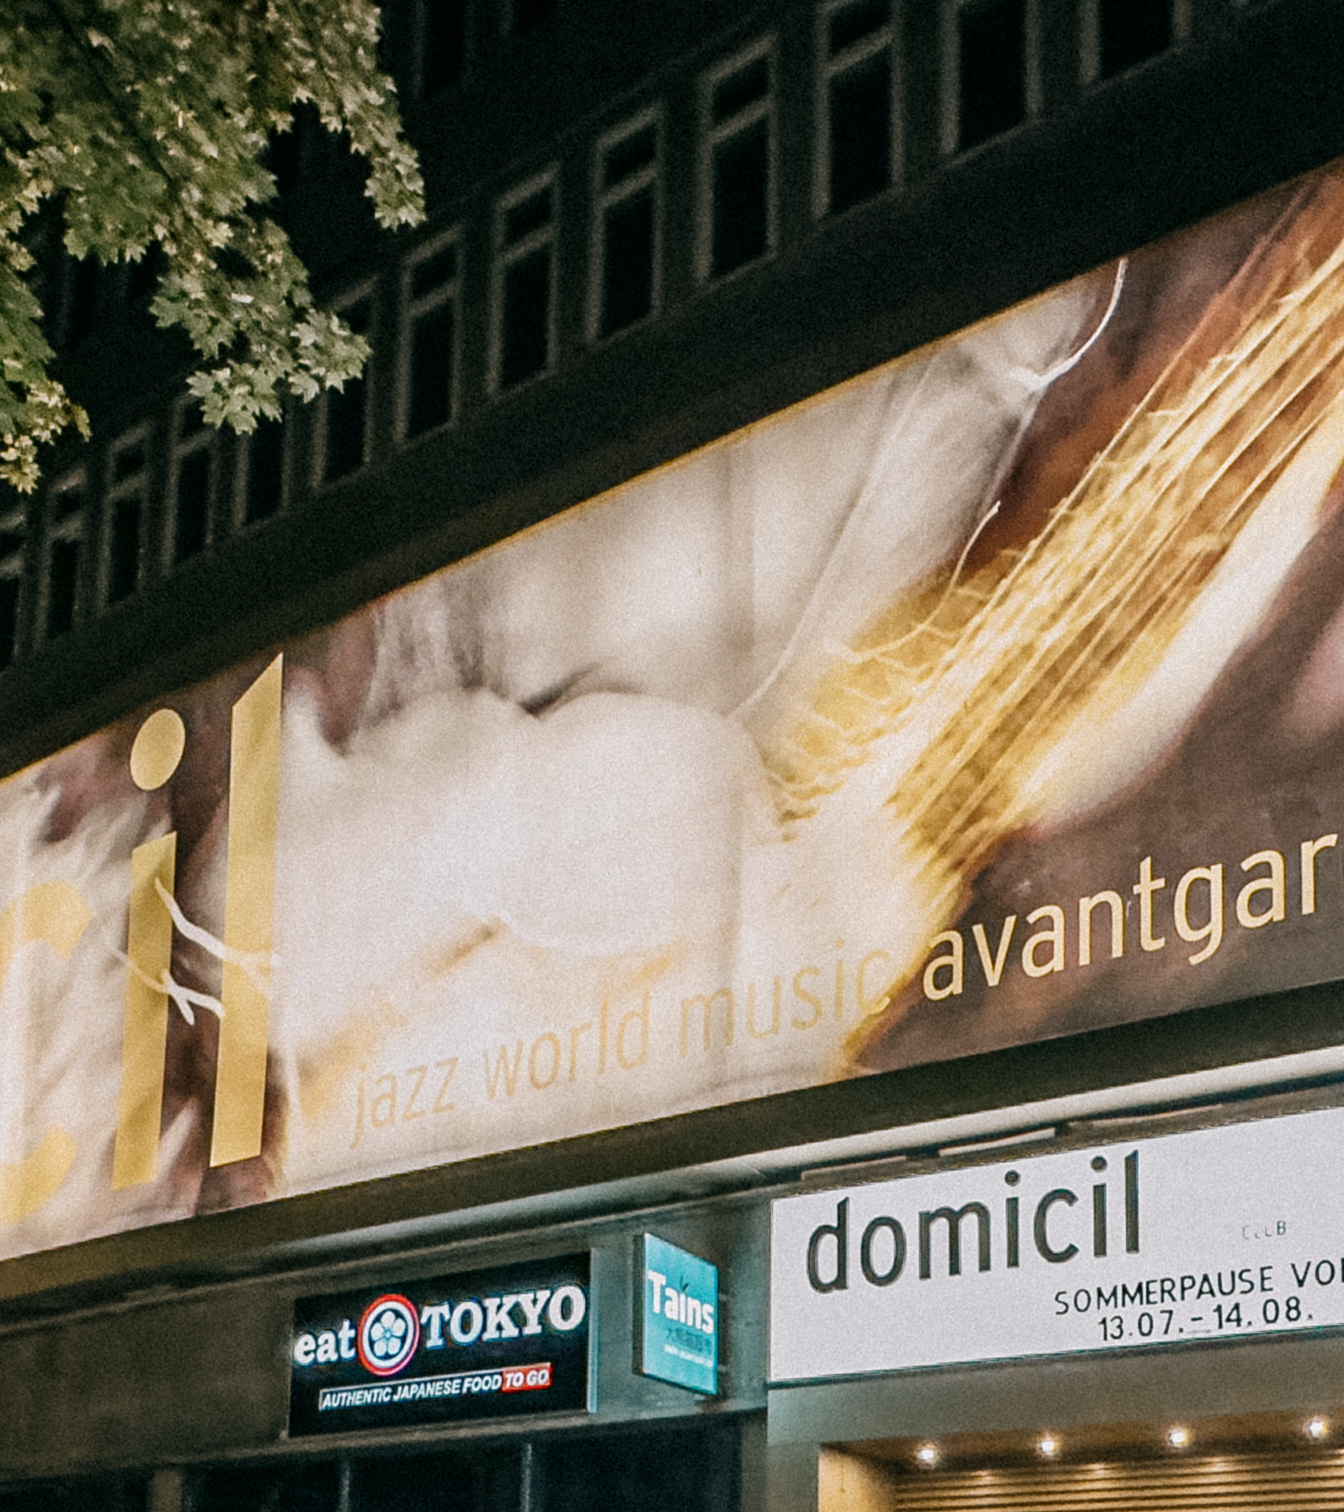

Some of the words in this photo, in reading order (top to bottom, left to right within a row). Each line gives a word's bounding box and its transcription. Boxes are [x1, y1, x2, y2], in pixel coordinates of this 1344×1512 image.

[349, 1056, 459, 1149] jazz
[483, 990, 651, 1100] world
[679, 937, 893, 1058] music
[805, 1150, 1141, 1295] domicil
[293, 1319, 356, 1367] eat
[420, 1283, 586, 1349] TOKYO
[647, 1269, 715, 1334] Tains
[1054, 1265, 1274, 1316] SOMMERPAUSE
[321, 1387, 393, 1409] AUTHENTIC
[393, 1380, 462, 1401] JAPANESE
[462, 1374, 502, 1394] FOOD
[505, 1372, 524, 1388] TO
[526, 1369, 550, 1386] GO
